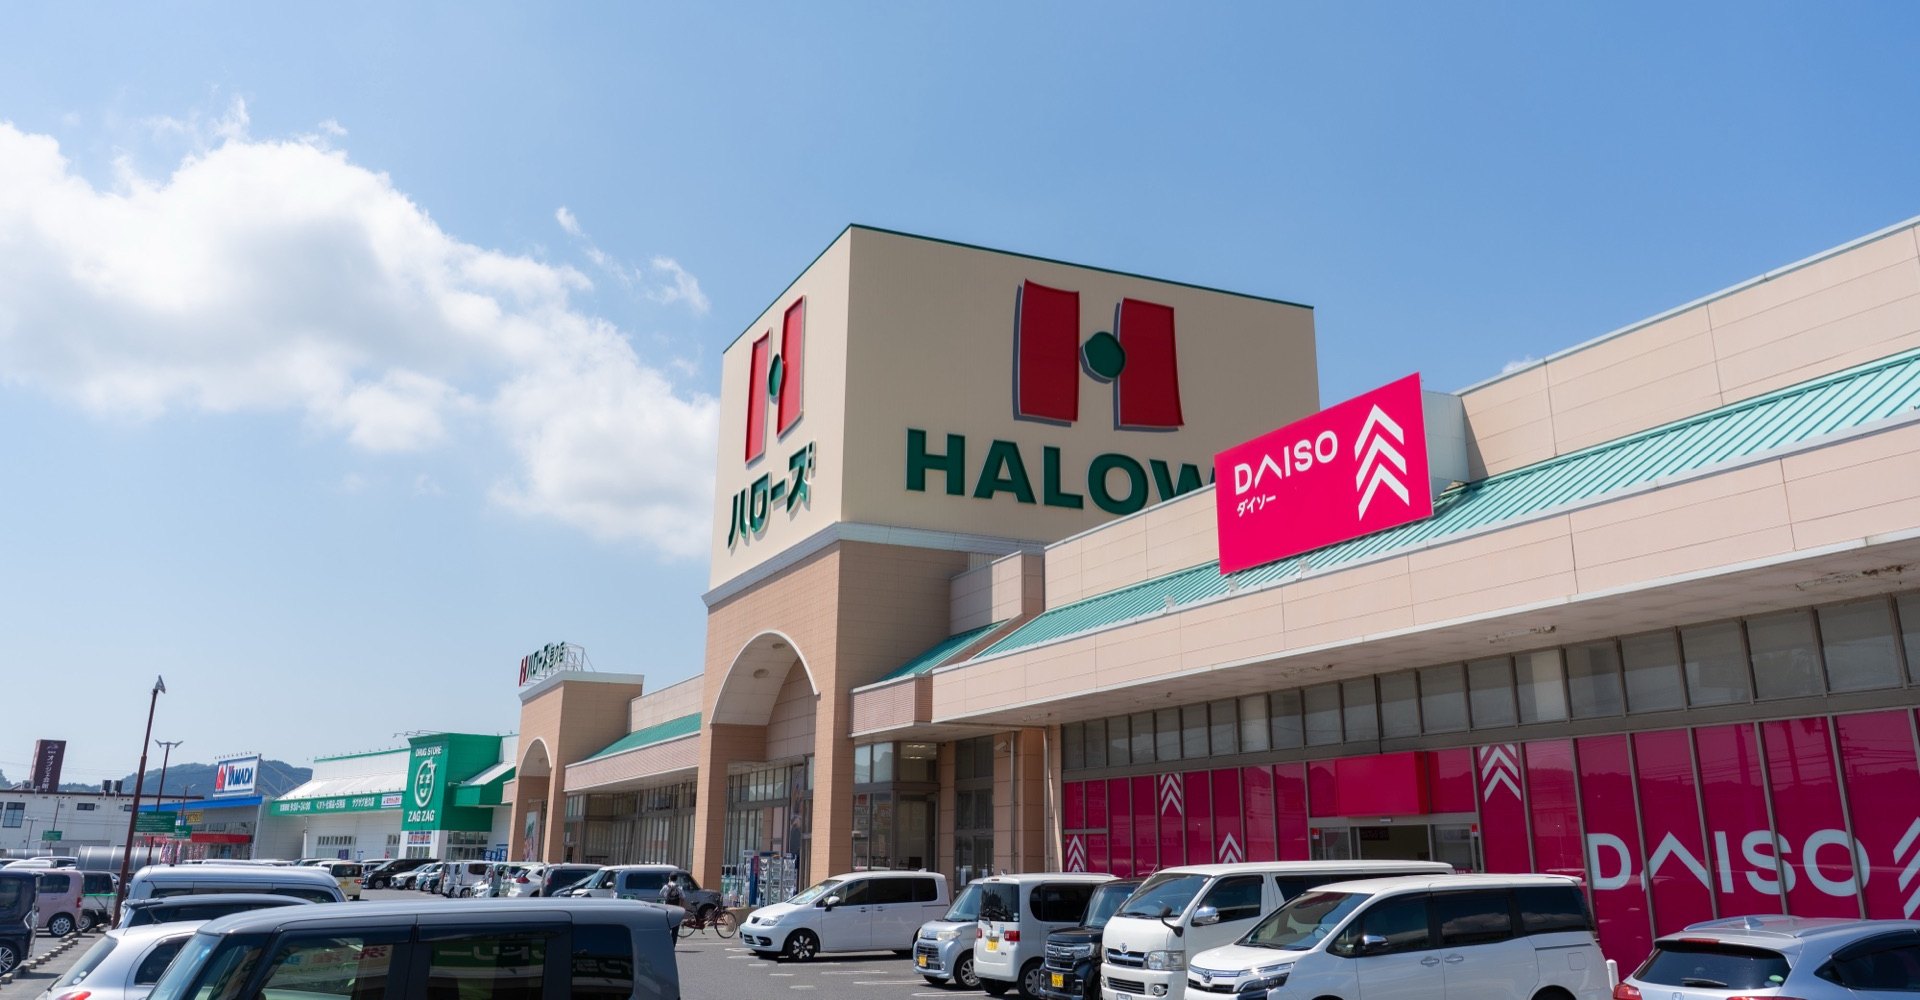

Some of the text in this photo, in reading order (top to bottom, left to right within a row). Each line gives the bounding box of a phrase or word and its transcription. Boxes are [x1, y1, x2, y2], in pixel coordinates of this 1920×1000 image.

[1234, 430, 1339, 496] DAISO
[727, 440, 817, 550] ハローズ
[1236, 492, 1277, 518] ダイソー
[415, 745, 442, 757] DRUG STORE
[408, 810, 435, 822] ZAG ZAG
[1587, 829, 1871, 897] DAISO
